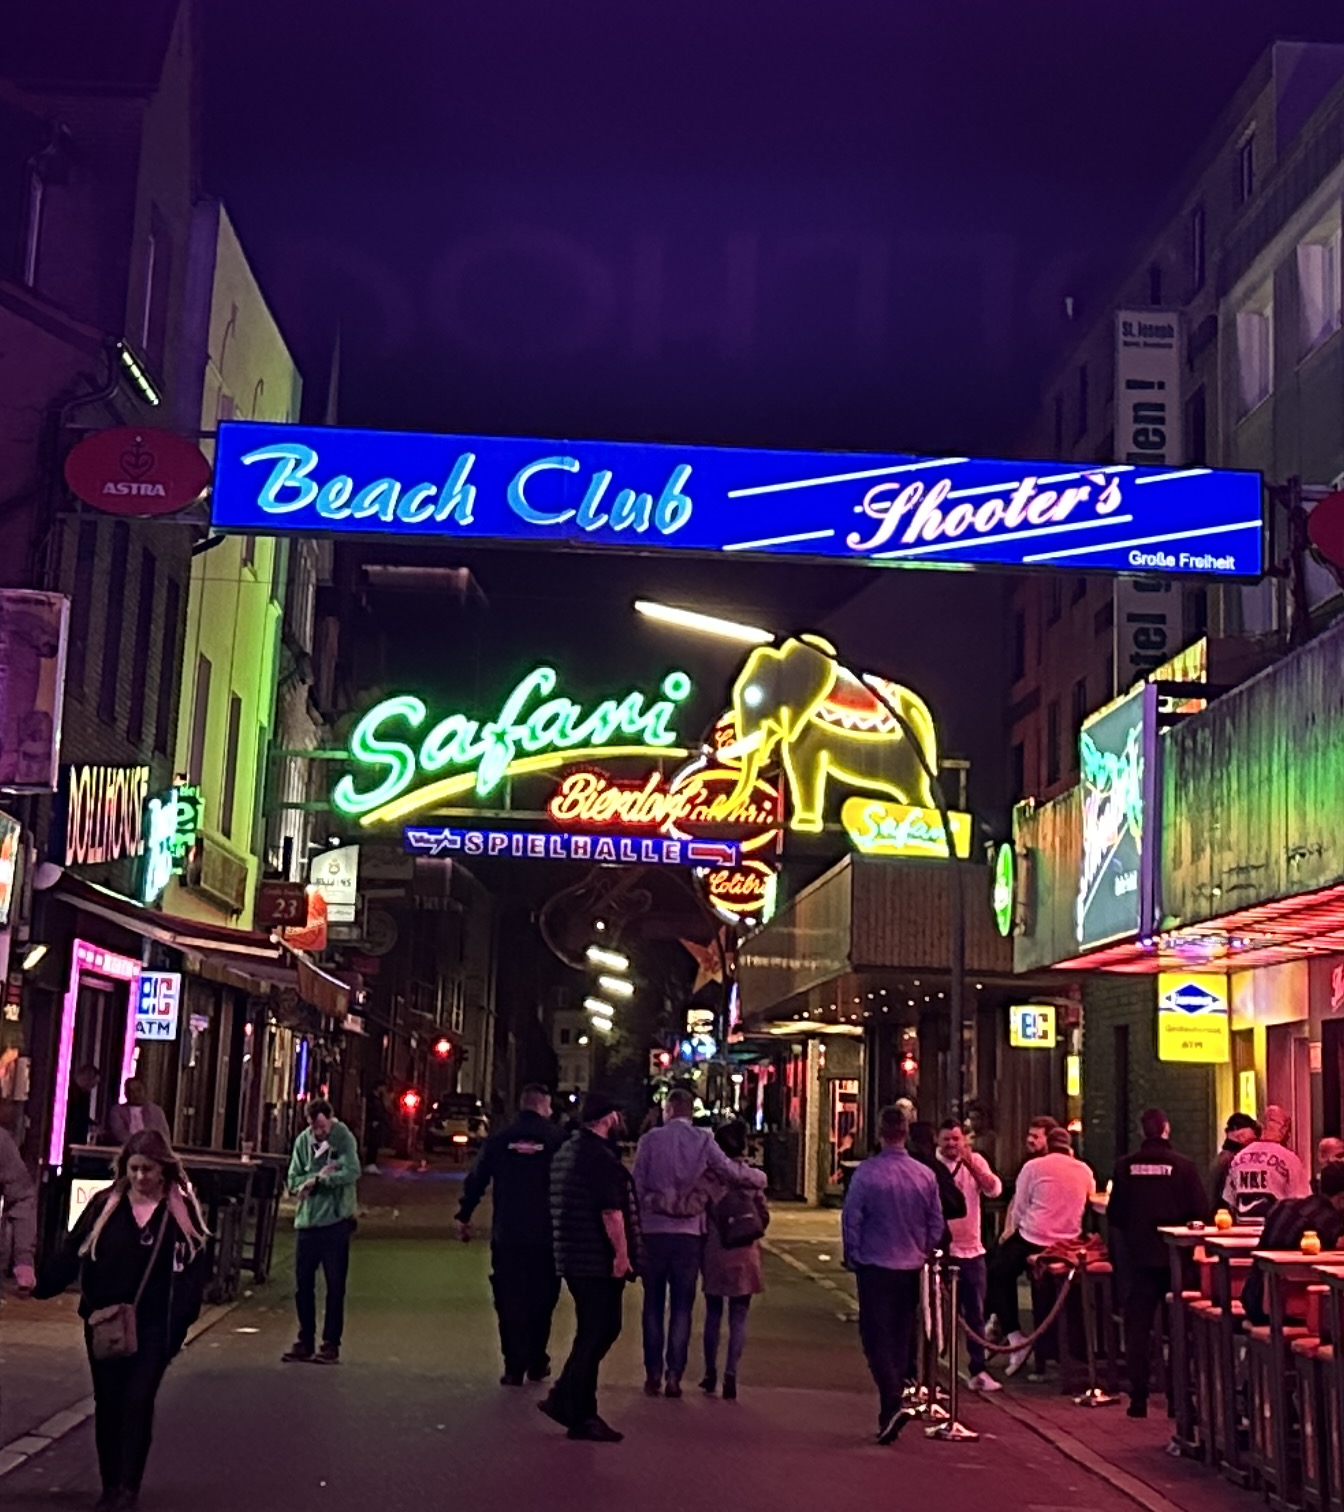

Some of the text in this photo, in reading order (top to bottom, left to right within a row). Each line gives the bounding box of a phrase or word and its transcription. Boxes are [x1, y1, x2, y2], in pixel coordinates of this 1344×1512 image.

[102, 481, 166, 497] ASTRA
[240, 443, 476, 526] Beach
[506, 455, 693, 535] Club
[1128, 550, 1236, 572] Große Freiheit
[334, 668, 691, 814] Safari
[271, 897, 298, 919] 23
[136, 1021, 171, 1035] ATM
